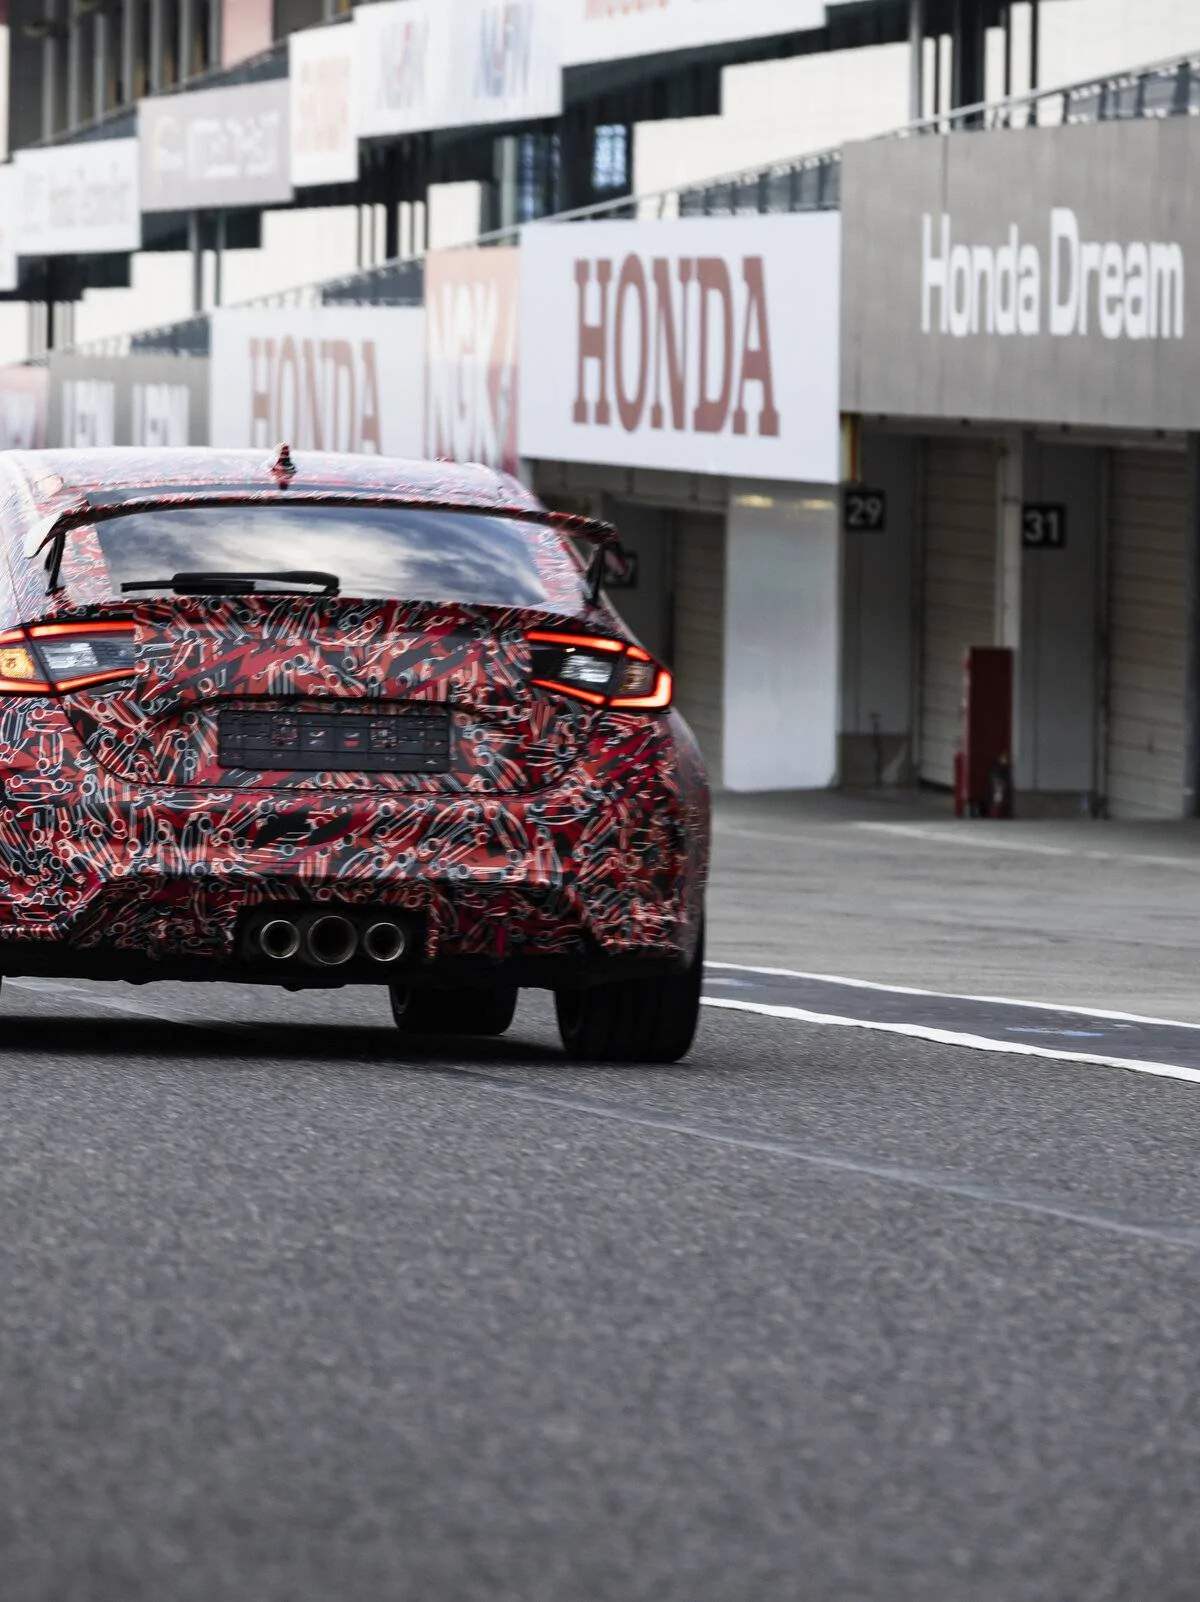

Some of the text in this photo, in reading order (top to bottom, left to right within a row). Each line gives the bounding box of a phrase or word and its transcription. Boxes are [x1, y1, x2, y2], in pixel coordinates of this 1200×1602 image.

[921, 206, 1184, 340] Honda Dream
[249, 335, 383, 455] HONDA
[572, 251, 780, 438] HONDA
[848, 496, 882, 526] 29
[1024, 510, 1059, 542] 31
